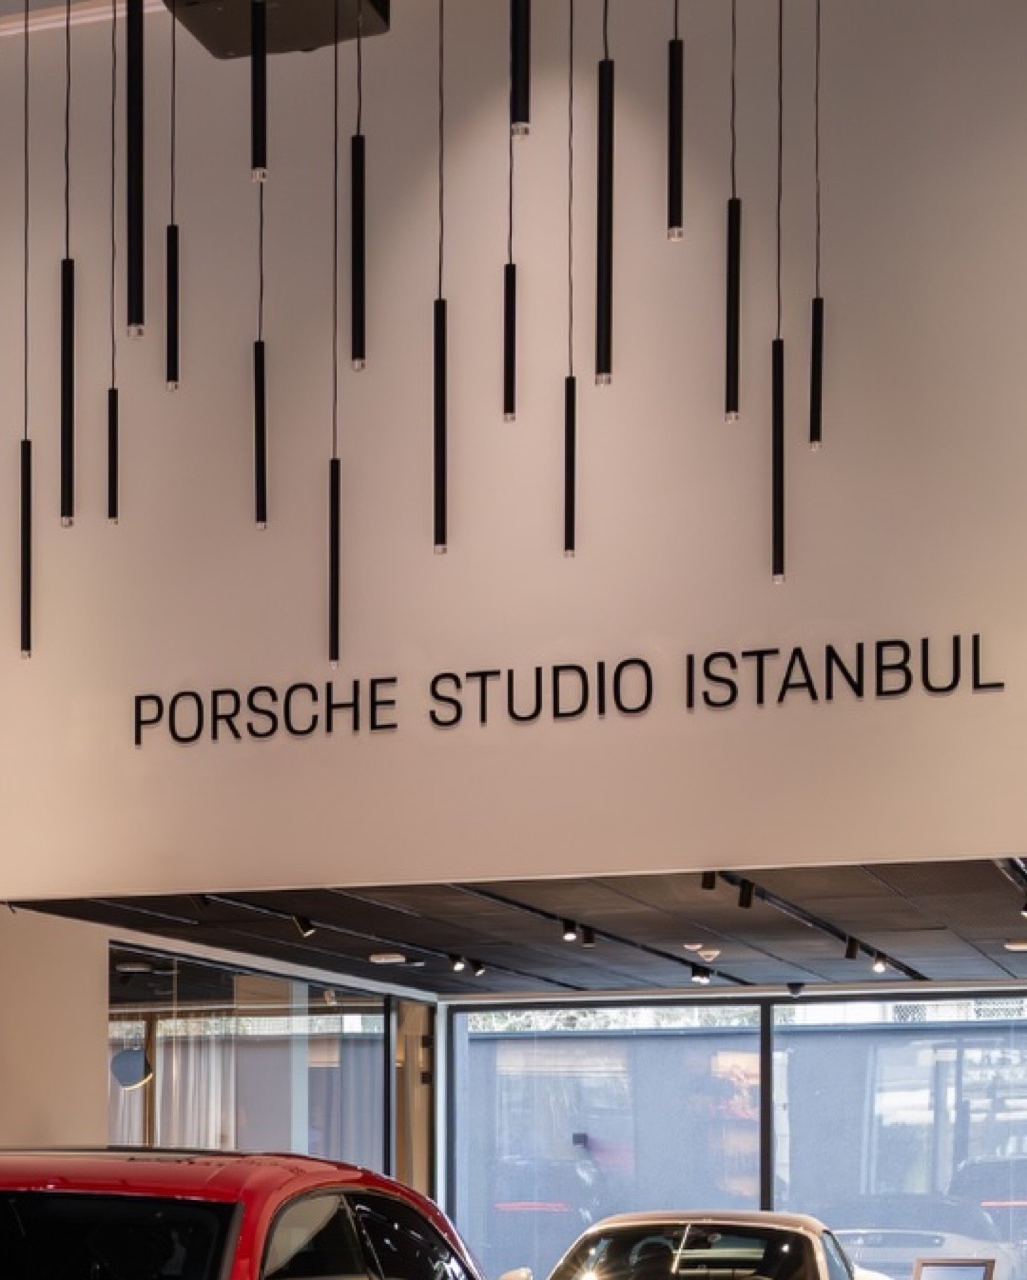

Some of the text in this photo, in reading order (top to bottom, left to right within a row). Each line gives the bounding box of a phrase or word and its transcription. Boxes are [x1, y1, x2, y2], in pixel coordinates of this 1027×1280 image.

[134, 634, 1005, 747] PORSCHE STUDIO ISTANBUL
